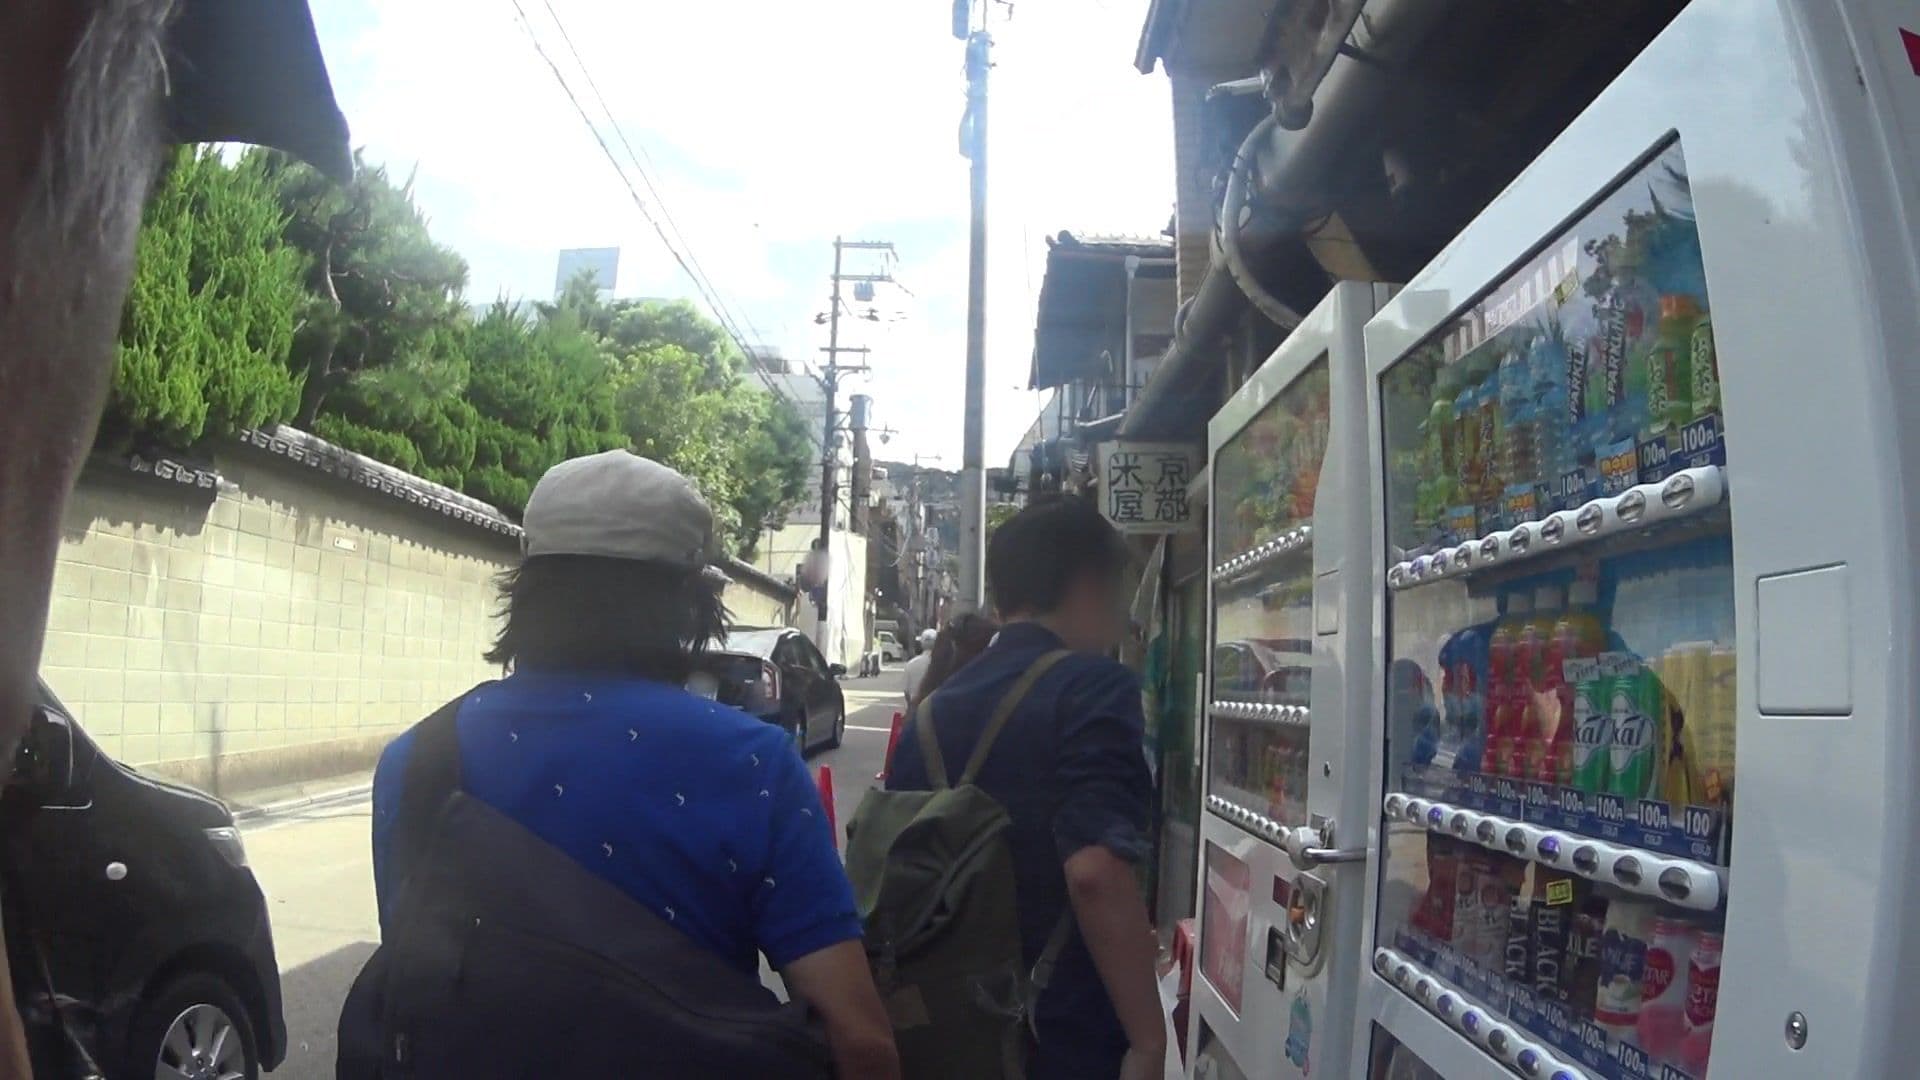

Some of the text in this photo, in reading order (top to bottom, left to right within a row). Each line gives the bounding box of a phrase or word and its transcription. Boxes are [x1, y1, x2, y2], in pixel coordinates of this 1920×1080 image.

[1569, 335, 1585, 425] SPARKLIN
[1110, 453, 1144, 520] 米屋
[1154, 456, 1191, 520] 京都
[1686, 810, 1710, 837] 100
[1536, 907, 1562, 998] BLACK
